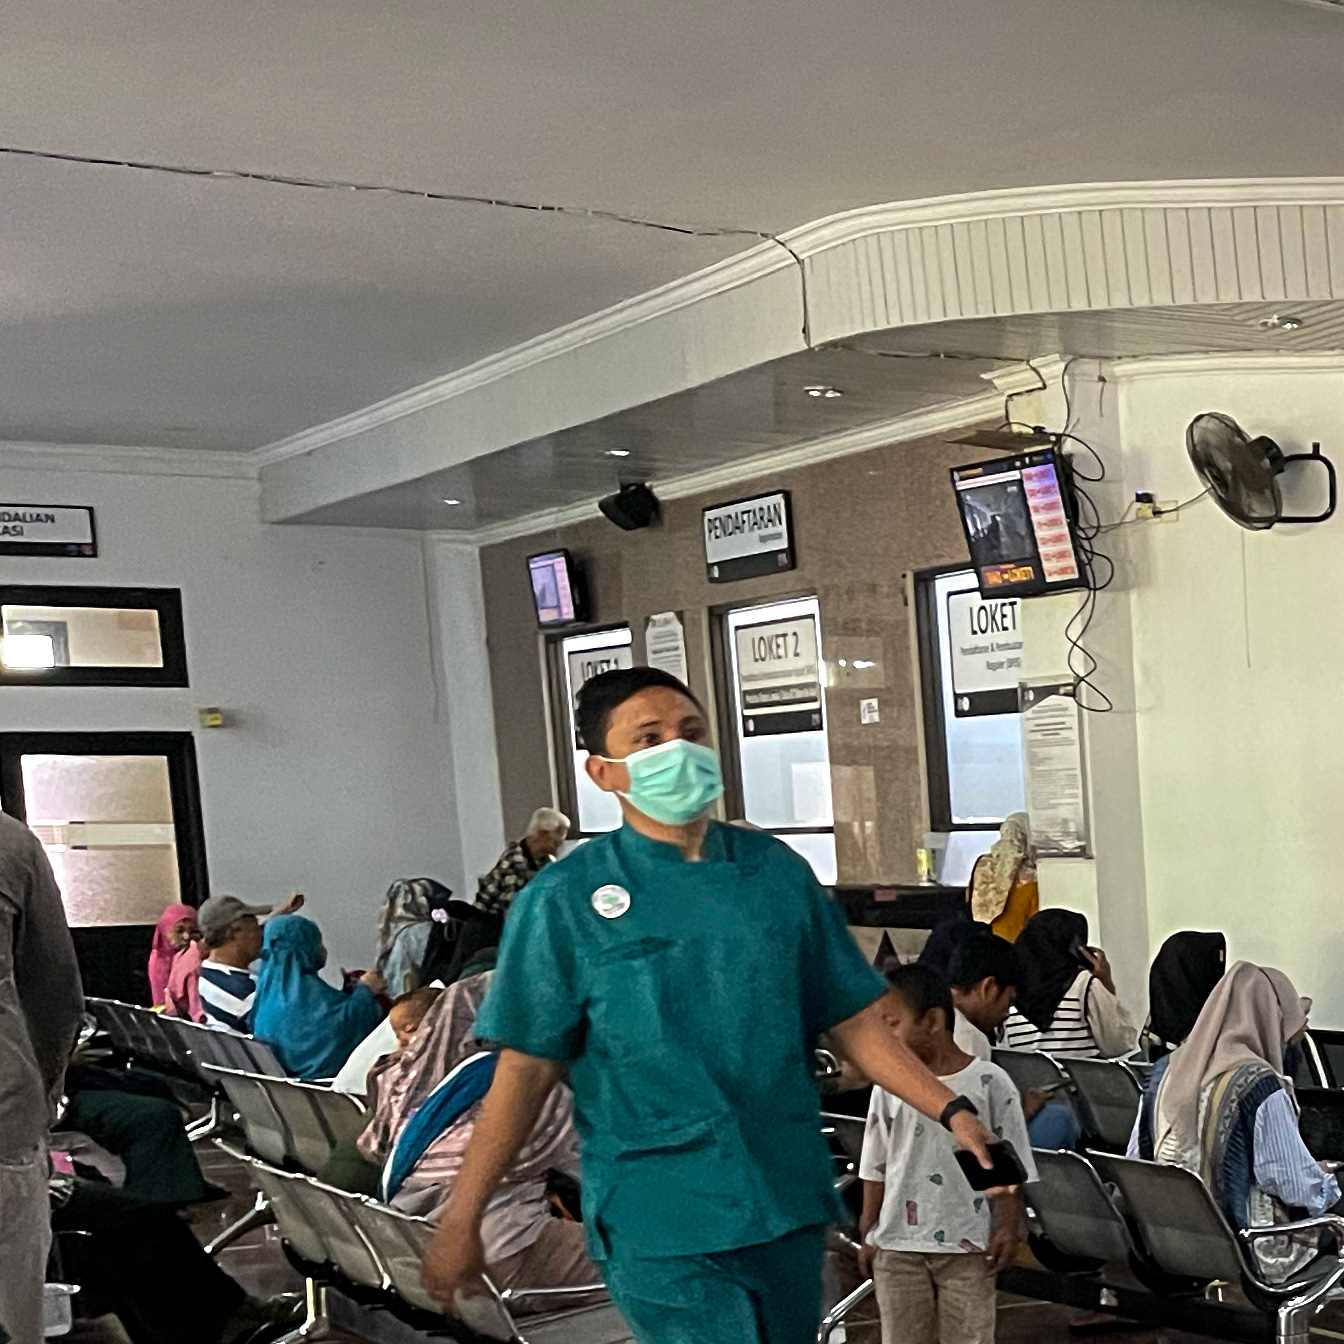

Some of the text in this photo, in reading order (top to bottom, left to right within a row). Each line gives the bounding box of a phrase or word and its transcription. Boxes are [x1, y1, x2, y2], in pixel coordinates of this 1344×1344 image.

[0, 511, 55, 524] DALIAN
[0, 524, 24, 536] ASI
[707, 503, 783, 541] PENDAFTARAN
[969, 601, 1018, 636] LOKET
[752, 631, 801, 663] LOKET 2
